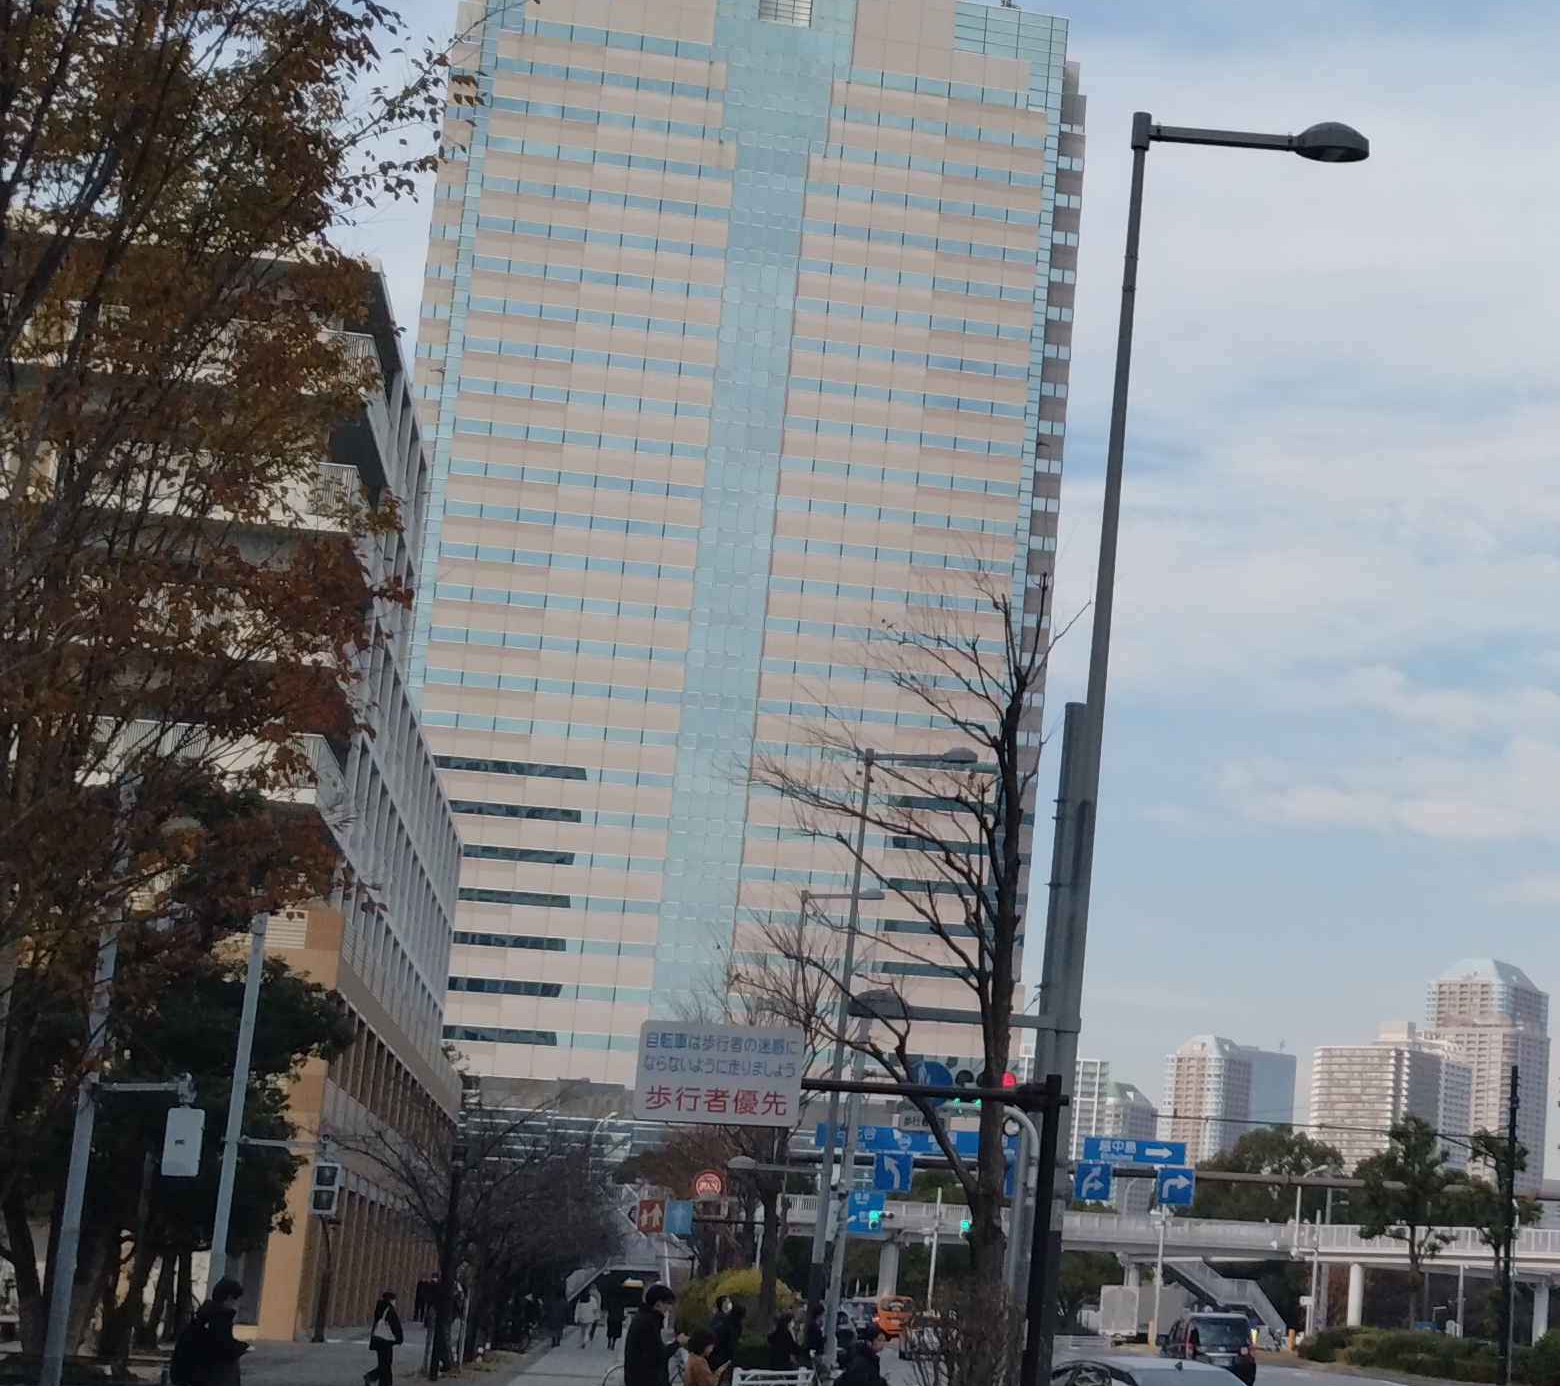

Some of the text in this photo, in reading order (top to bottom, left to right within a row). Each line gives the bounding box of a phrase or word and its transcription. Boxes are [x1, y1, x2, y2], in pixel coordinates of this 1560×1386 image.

[646, 1032, 798, 1055] 自転車は歩行者の迷惑に
[644, 1055, 796, 1078] ならないように走りましょう
[645, 1084, 787, 1116] 歩行者優先
